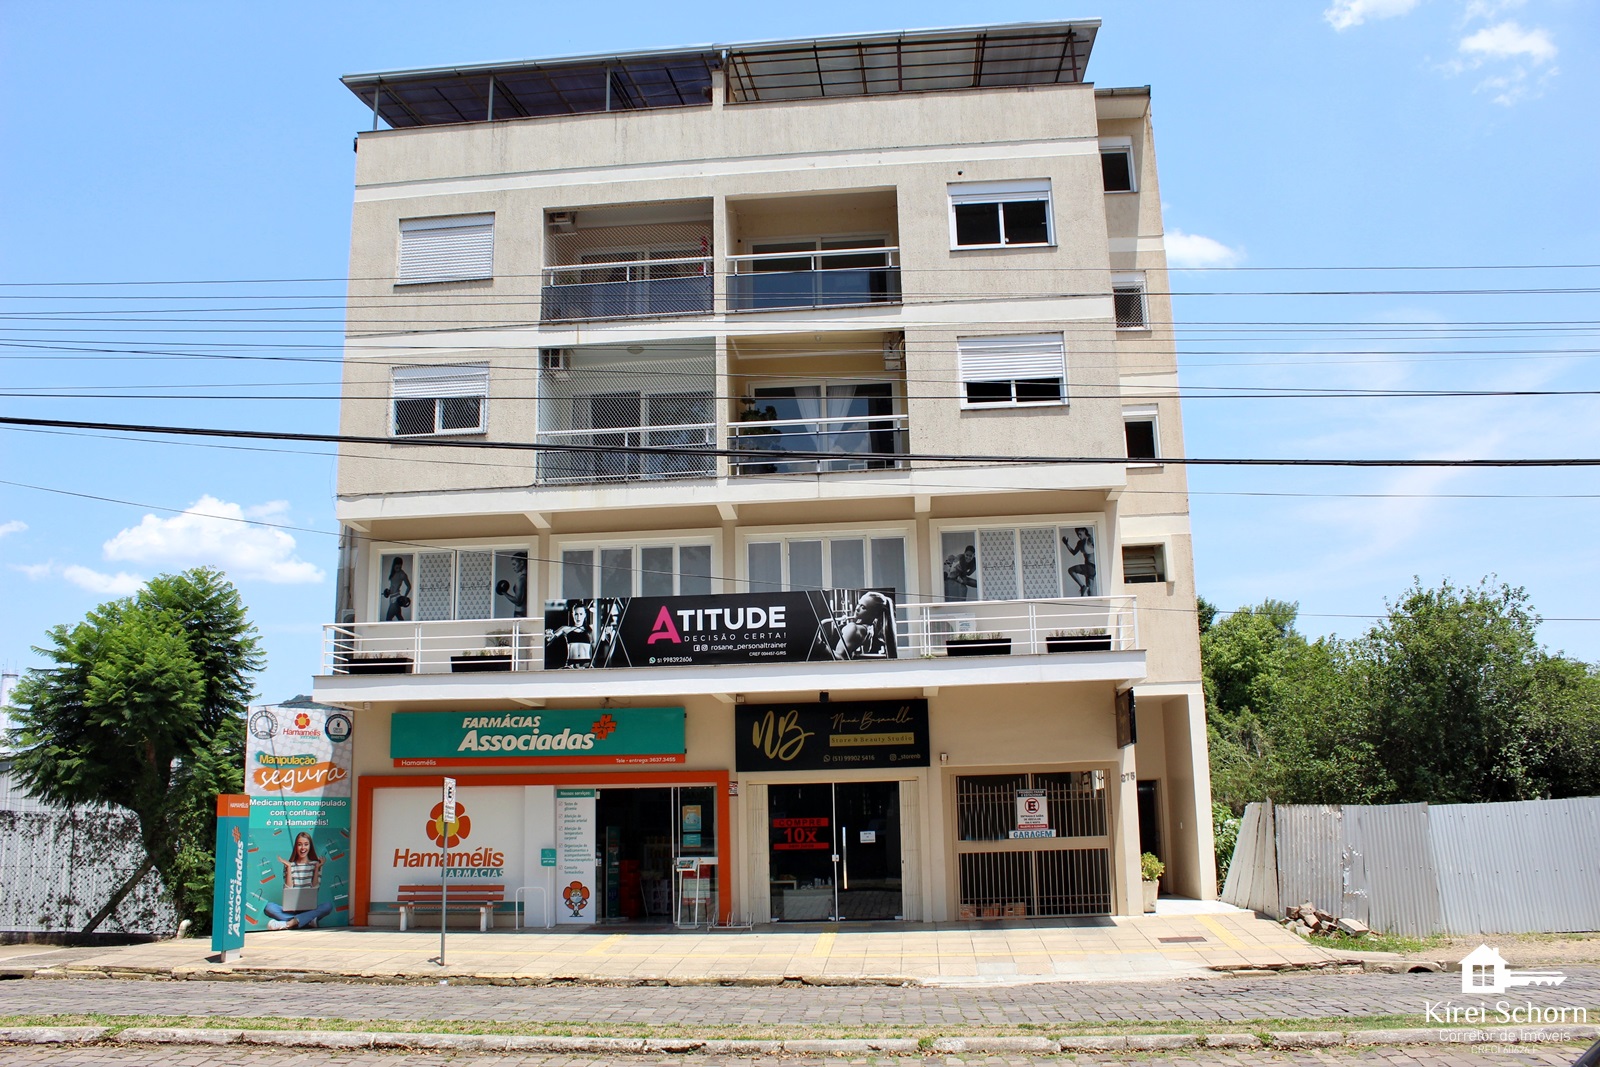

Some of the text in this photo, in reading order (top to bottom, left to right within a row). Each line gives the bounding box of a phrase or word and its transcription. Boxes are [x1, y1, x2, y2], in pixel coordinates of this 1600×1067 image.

[647, 605, 786, 644] ATITUDE
[684, 632, 786, 642] DECISÃO CERTA!
[710, 642, 787, 652] rosane_personaltrainer
[462, 714, 541, 728] FARMÁCIAS
[282, 728, 320, 736] Hamamélis
[457, 728, 596, 752] Associadas
[260, 754, 316, 766] Manipulação
[260, 768, 346, 790] segura
[304, 800, 346, 808] manipulado
[289, 809, 326, 818] confiança
[784, 828, 818, 842] 10x
[393, 846, 504, 868] Hamamélis
[232, 840, 244, 938] Associadas
